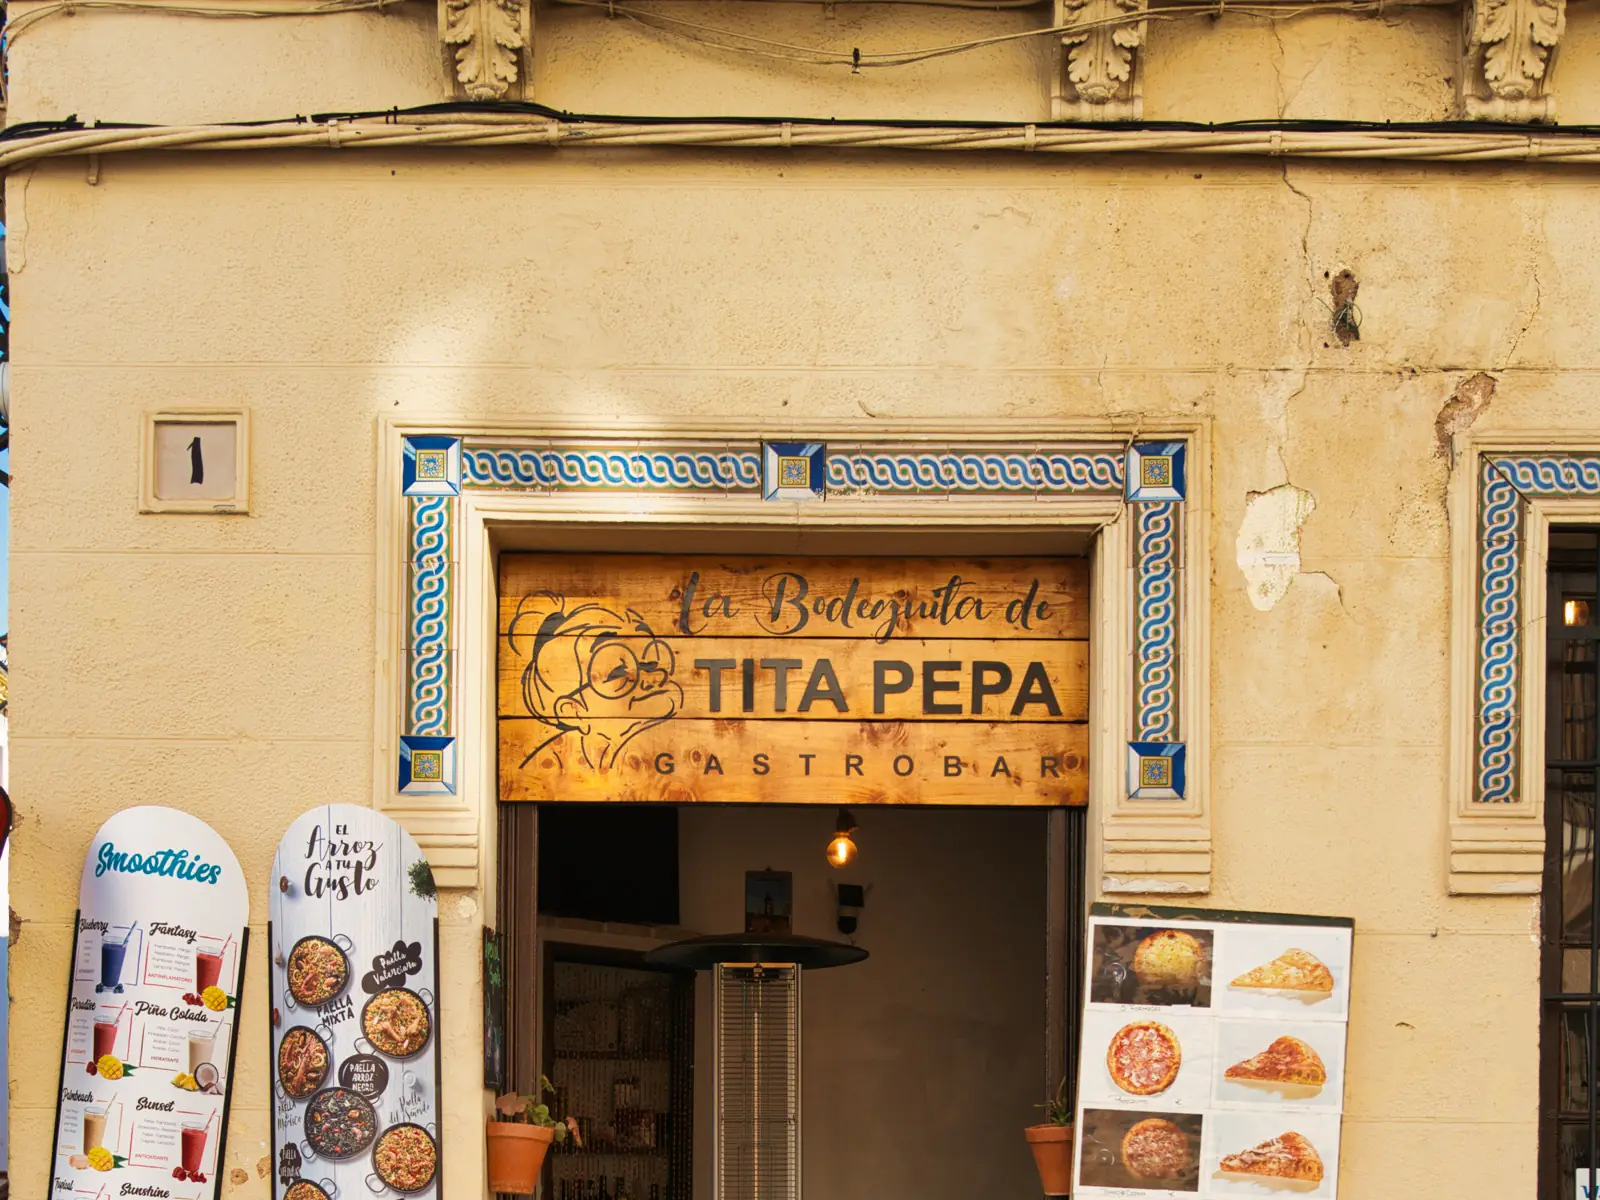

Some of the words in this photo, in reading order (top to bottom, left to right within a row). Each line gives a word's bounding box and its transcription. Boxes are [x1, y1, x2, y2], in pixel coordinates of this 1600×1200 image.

[186, 436, 204, 485] 1
[679, 571, 740, 635] La
[754, 571, 993, 645] Bodeguita
[1004, 577, 1055, 631] de
[694, 658, 850, 713] TITA
[873, 660, 1064, 717] PEPA
[654, 752, 1061, 779] GASTROBAR
[335, 823, 350, 836] EL
[304, 824, 384, 872] Arroz
[95, 841, 222, 885] Smoothies
[325, 860, 333, 871] A
[336, 859, 351, 871] TU
[304, 859, 380, 902] Gusto
[149, 921, 198, 945] Fantasy
[379, 950, 407, 969] Paella
[372, 959, 418, 986] Valenciana
[134, 1000, 168, 1017] Piña
[169, 1006, 208, 1023] Colada
[315, 993, 354, 1018] PAELLA
[321, 1006, 356, 1029] MIXTA
[349, 1062, 376, 1073] PAELLA
[351, 1072, 374, 1082] ARROZ
[351, 1081, 375, 1092] NEGRO
[135, 1096, 175, 1113] Sunset
[119, 1182, 171, 1199] Sunshine
